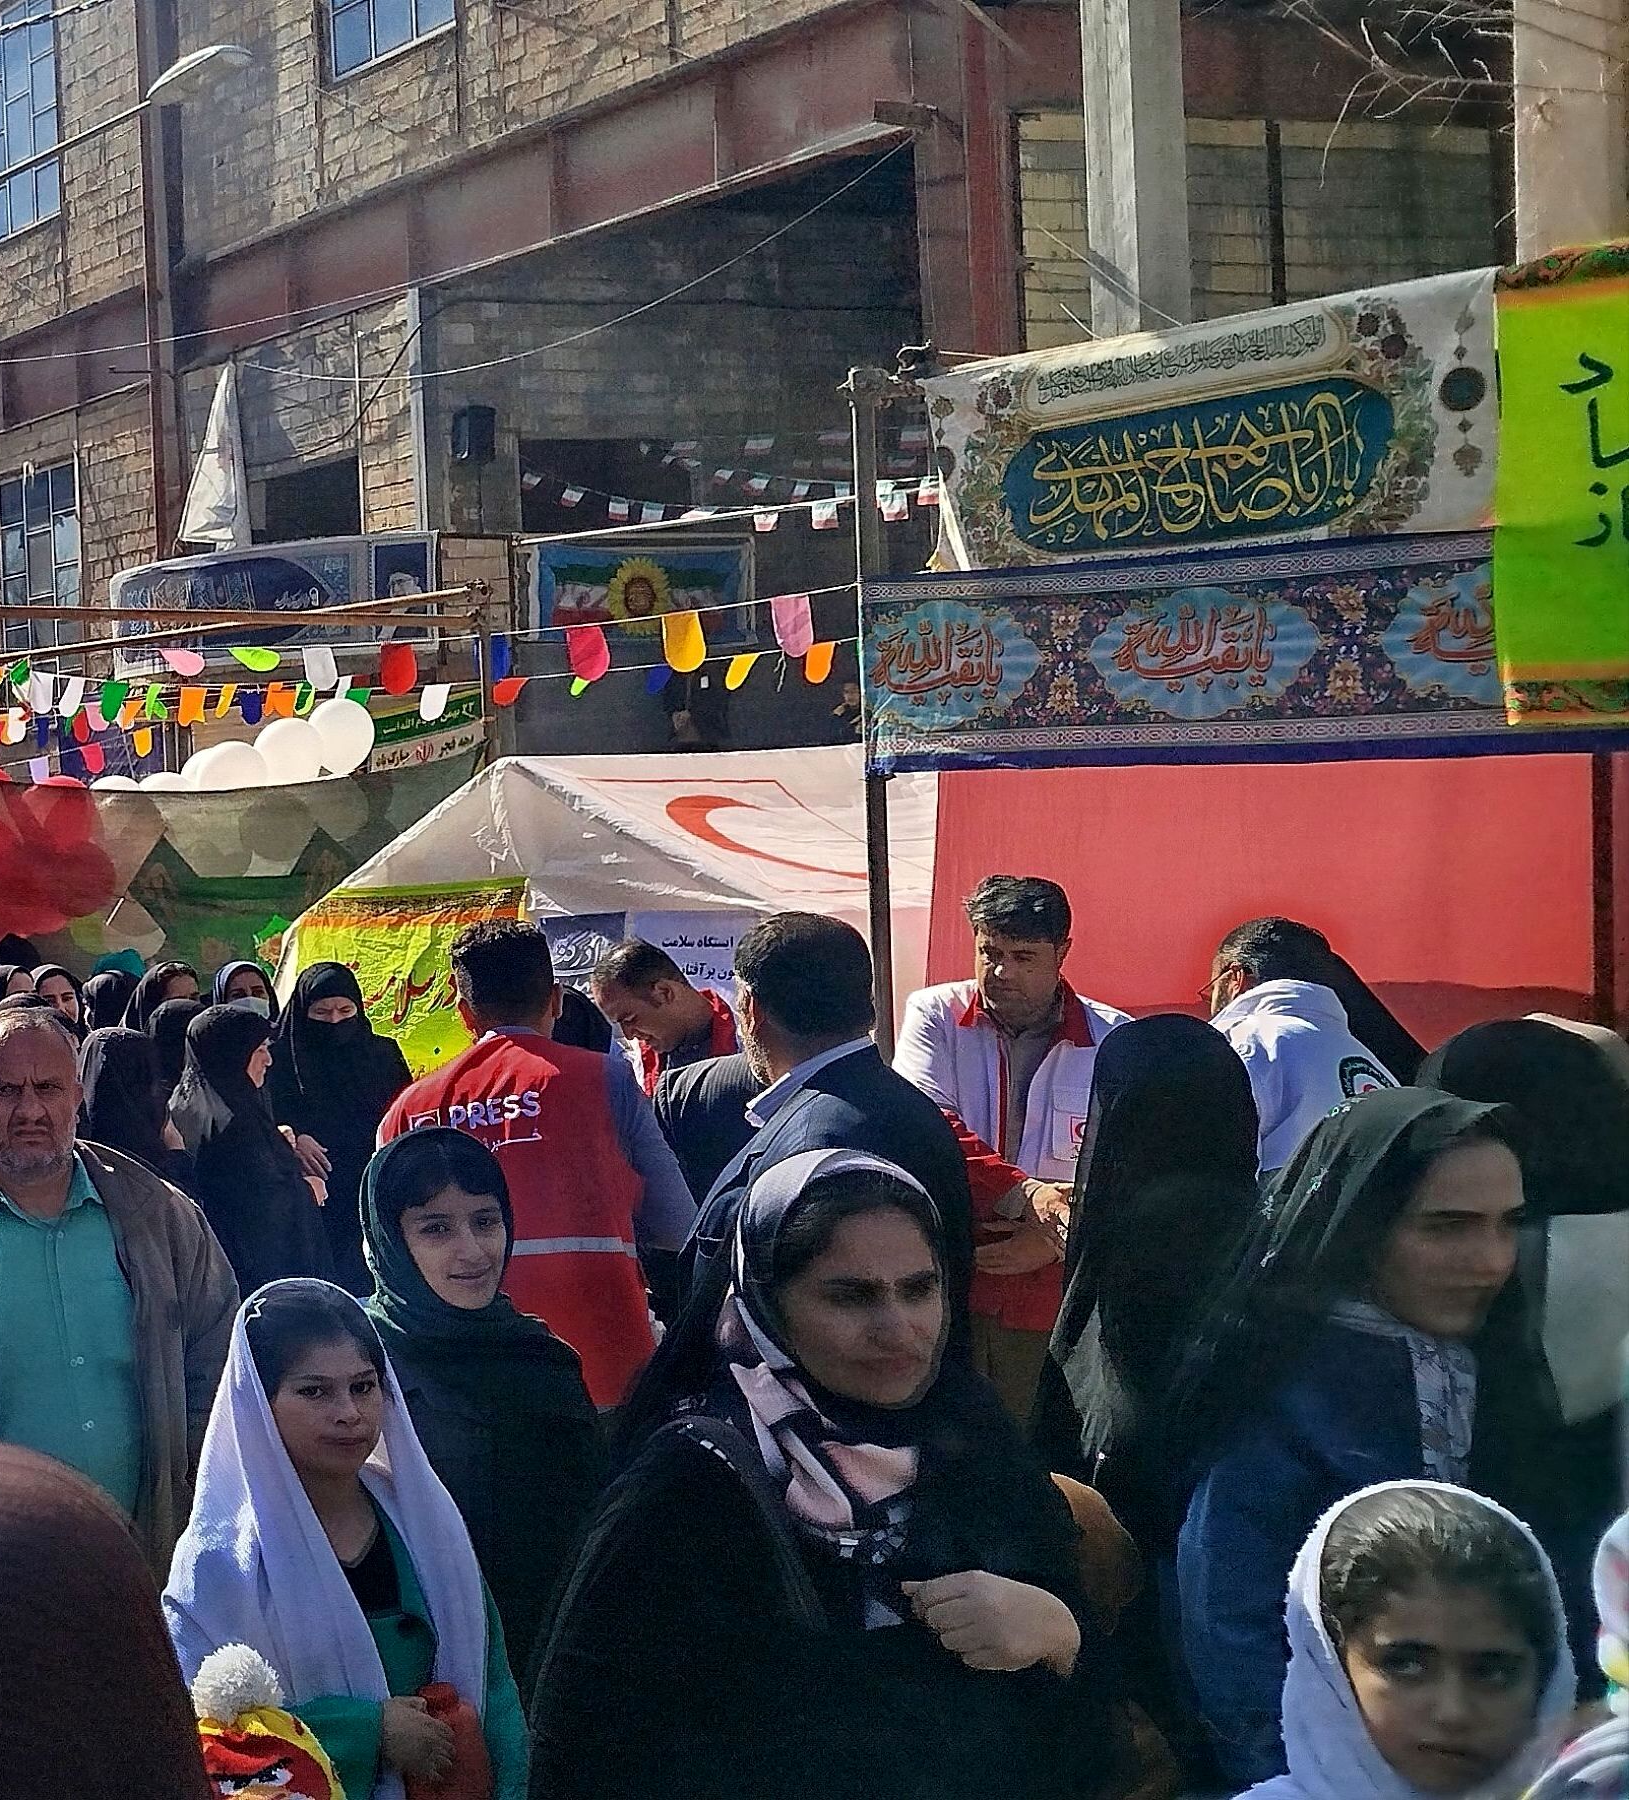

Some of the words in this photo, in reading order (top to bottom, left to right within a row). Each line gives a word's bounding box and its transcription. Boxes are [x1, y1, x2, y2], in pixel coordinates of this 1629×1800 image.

[661, 934, 695, 948] سلامت
[696, 935, 734, 951] ایستگاه
[449, 1090, 542, 1129] PRESS
